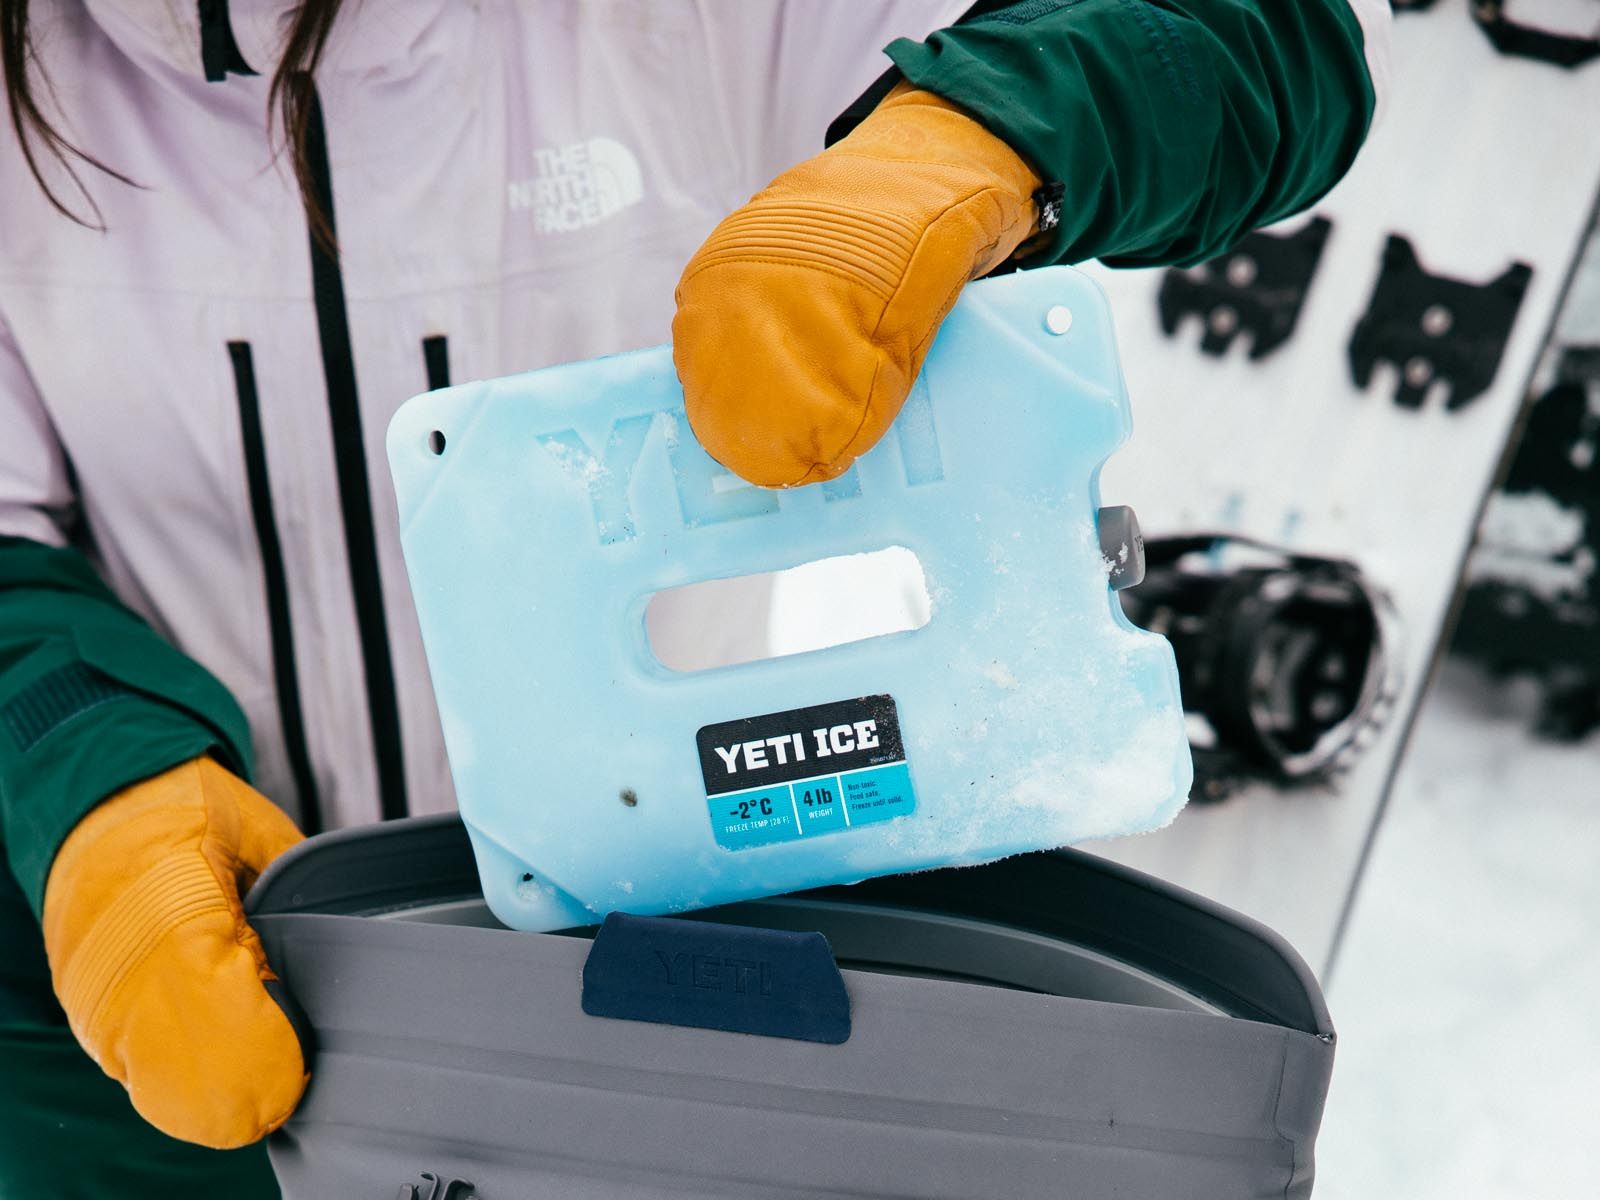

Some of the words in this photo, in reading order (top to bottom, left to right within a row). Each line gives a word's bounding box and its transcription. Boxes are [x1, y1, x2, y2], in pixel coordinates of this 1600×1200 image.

[532, 144, 585, 178] THE
[508, 171, 593, 211] NRTH
[535, 362, 946, 546] YEI
[714, 732, 806, 774] YETI
[812, 719, 880, 758] ICE
[803, 790, 813, 807] 4
[815, 787, 833, 805] lb
[808, 807, 833, 820] WEIGHT
[751, 819, 769, 829] TEMP
[655, 950, 775, 997] YETI
